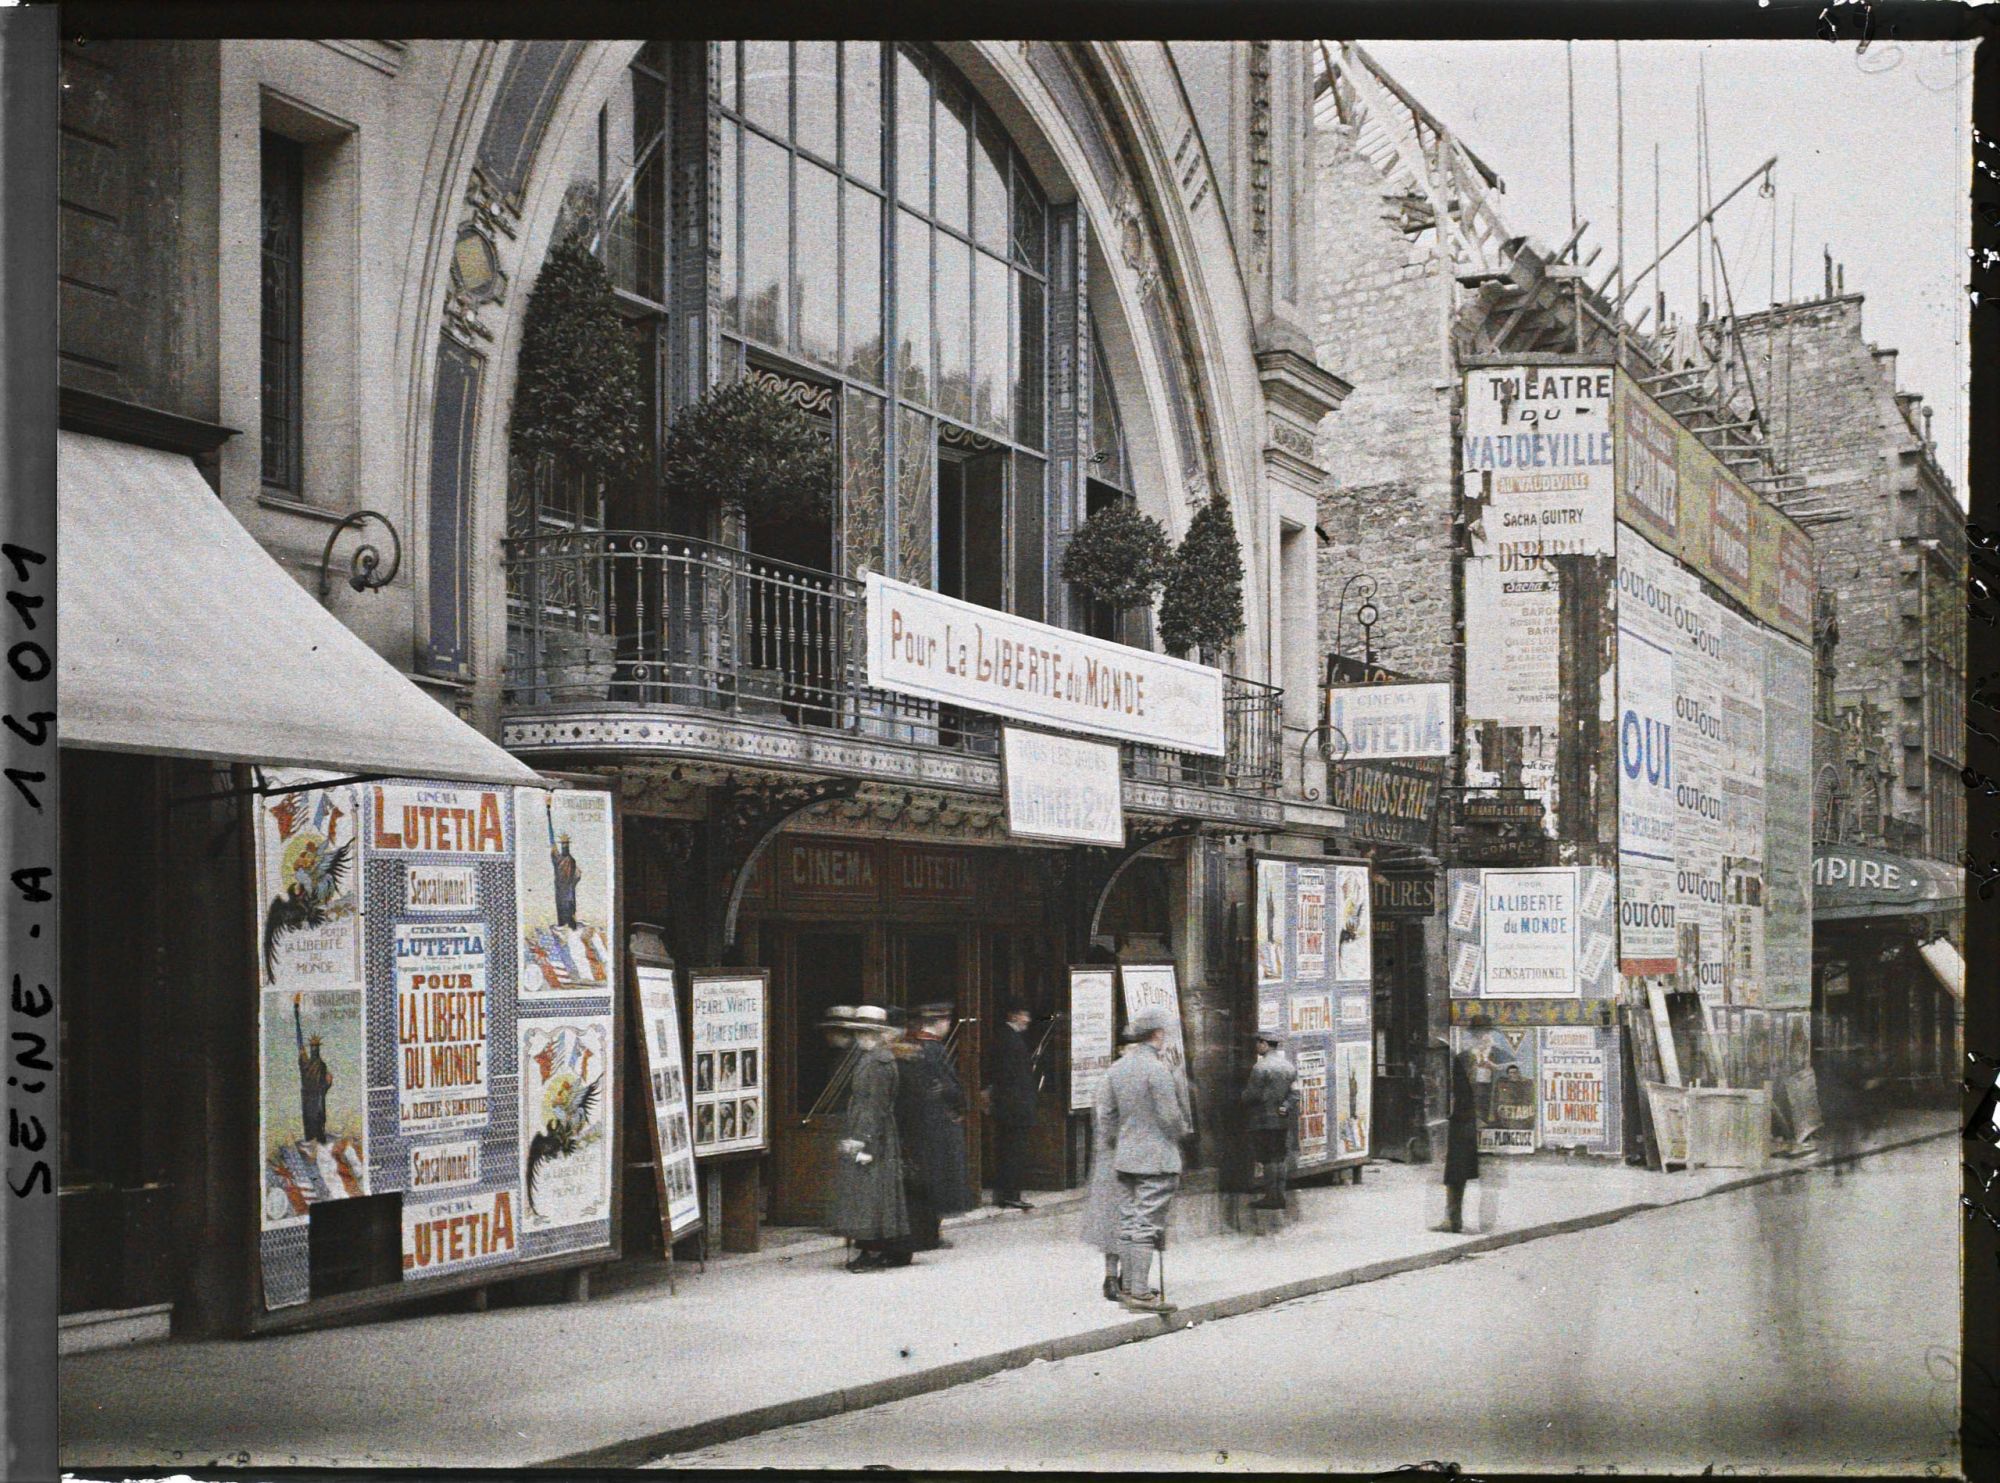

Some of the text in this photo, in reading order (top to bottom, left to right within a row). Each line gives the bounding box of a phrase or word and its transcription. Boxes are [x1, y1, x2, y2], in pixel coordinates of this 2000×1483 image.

[1520, 409, 1561, 422] DU
[1541, 508, 1584, 525] GUITRY
[1620, 567, 1645, 600] OUI
[1647, 584, 1673, 619] OUI
[1674, 606, 1698, 636] OUI
[1699, 630, 1720, 660] OUI
[891, 608, 936, 669] Pour
[946, 625, 967, 677] La
[1066, 660, 1082, 704] du
[1084, 656, 1145, 717] MONDE
[1334, 691, 1444, 753] LUTETIA
[1676, 695, 1699, 725] OUI
[1699, 712, 1721, 741] OUI
[1621, 709, 1671, 790] OUI
[1676, 784, 1699, 811] OUI
[1700, 795, 1721, 822] OUI
[373, 784, 504, 853] LUTETIA
[791, 846, 874, 886] CINEMA
[1677, 871, 1700, 895] OUI
[1700, 879, 1721, 904] OUI
[1490, 894, 1563, 912] LA LIBERTE
[1622, 901, 1649, 928] OUI
[1651, 903, 1675, 929] OUI
[411, 925, 468, 934] CINEMA
[1503, 917, 1567, 934] du MONDE
[396, 935, 484, 957] LUTETIA
[411, 973, 473, 990] POUR
[1491, 967, 1568, 980] SENSATIONNEL
[1701, 962, 1723, 986] OUI
[399, 993, 418, 1044] LA
[423, 990, 487, 1042] LIBERTE
[694, 996, 757, 1015] PEARL WHITE
[404, 1042, 483, 1090] DU MONDE
[1543, 1055, 1601, 1065] LUTETIA
[1553, 1071, 1594, 1079] POUR
[1544, 1079, 1603, 1103] LA LIBERTE
[1547, 1103, 1561, 1121] DU
[1564, 1103, 1600, 1122] MONDE
[402, 1191, 516, 1270] UTETIA
